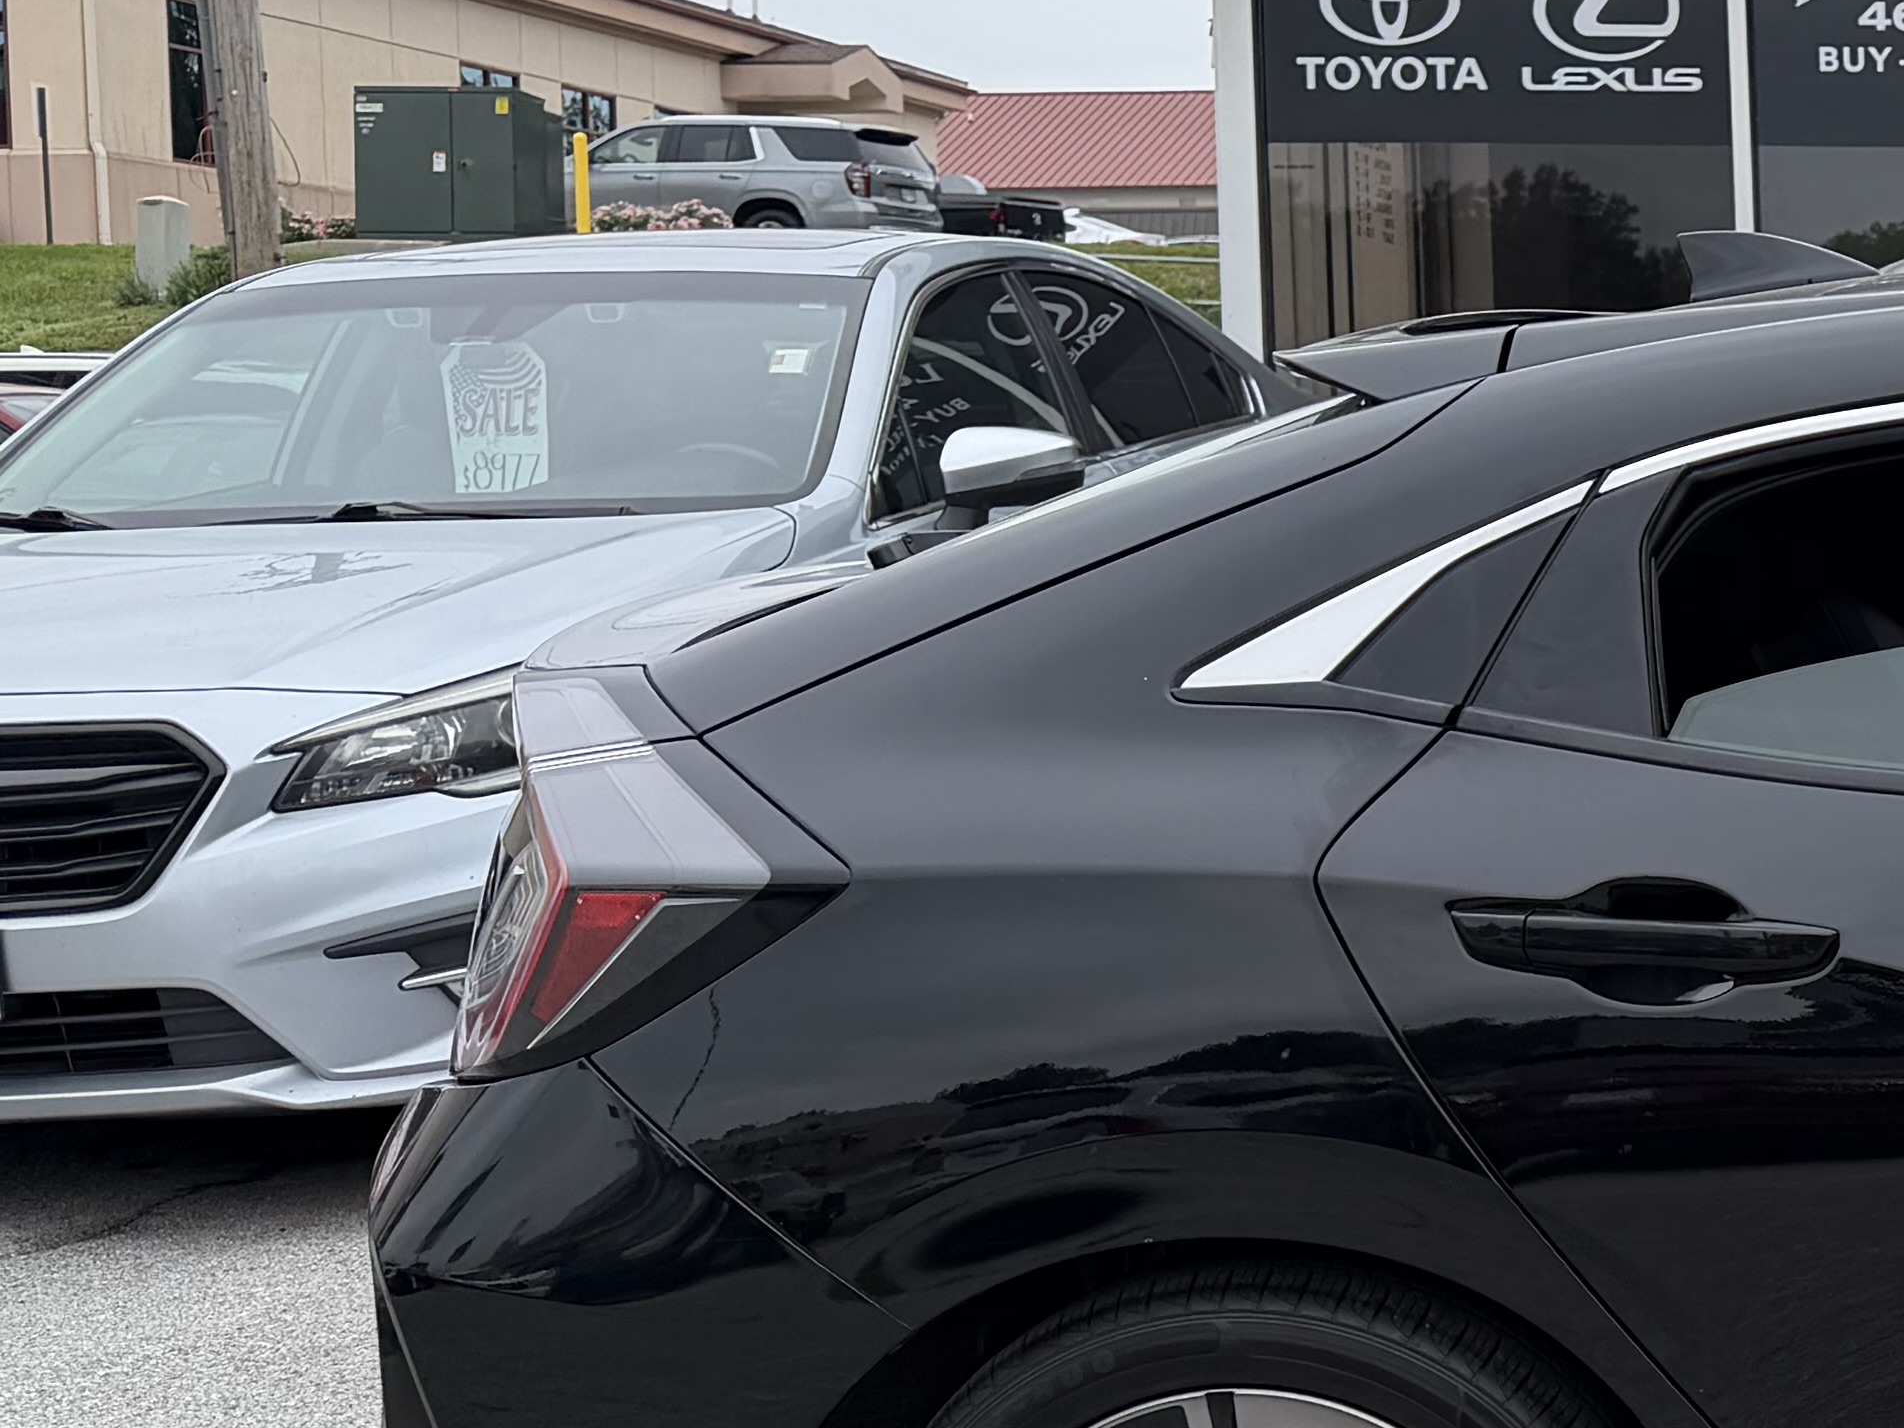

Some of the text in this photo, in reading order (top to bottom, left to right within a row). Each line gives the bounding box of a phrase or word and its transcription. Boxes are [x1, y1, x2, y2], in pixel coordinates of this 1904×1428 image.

[1295, 56, 1489, 92] TOYOTA
[1520, 65, 1704, 93] LEXUS
[458, 387, 541, 438] SALE
[463, 450, 541, 492] $8977
